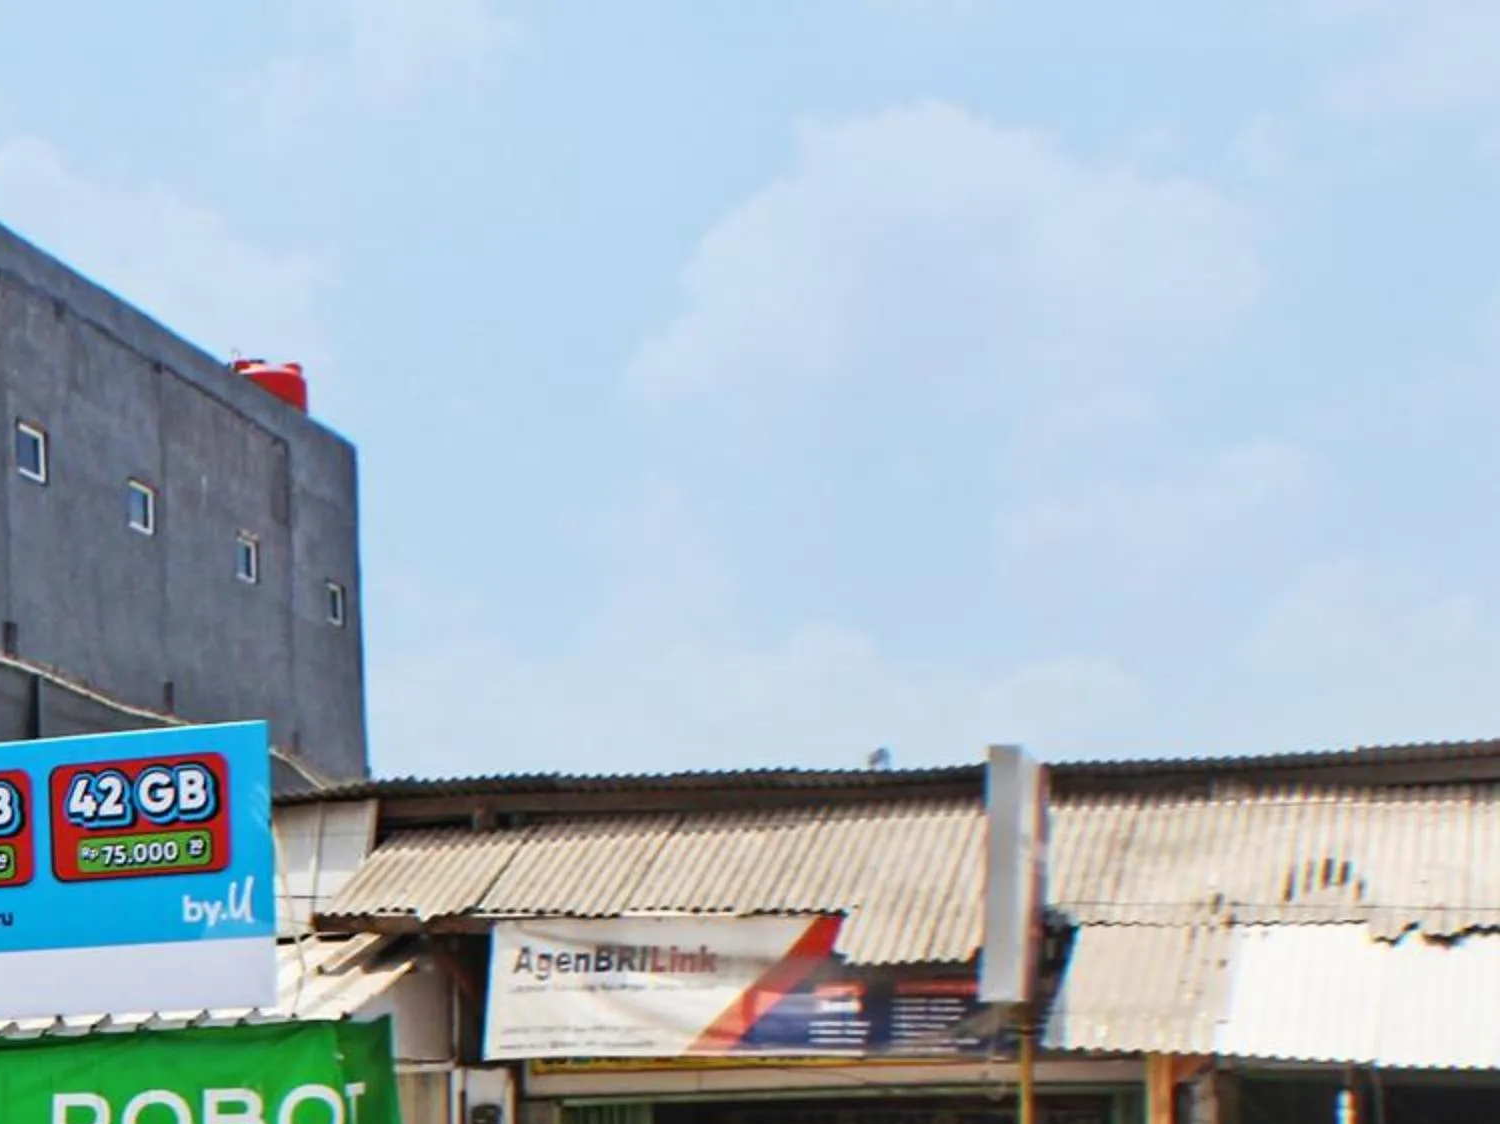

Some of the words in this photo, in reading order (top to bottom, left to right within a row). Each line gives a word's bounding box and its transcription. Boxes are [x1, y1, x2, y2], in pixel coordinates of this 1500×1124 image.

[69, 773, 125, 817] 42
[139, 769, 207, 812] GB
[81, 846, 98, 861] Rp
[102, 841, 177, 866] 75.000
[513, 944, 717, 980] AgenBRILink
